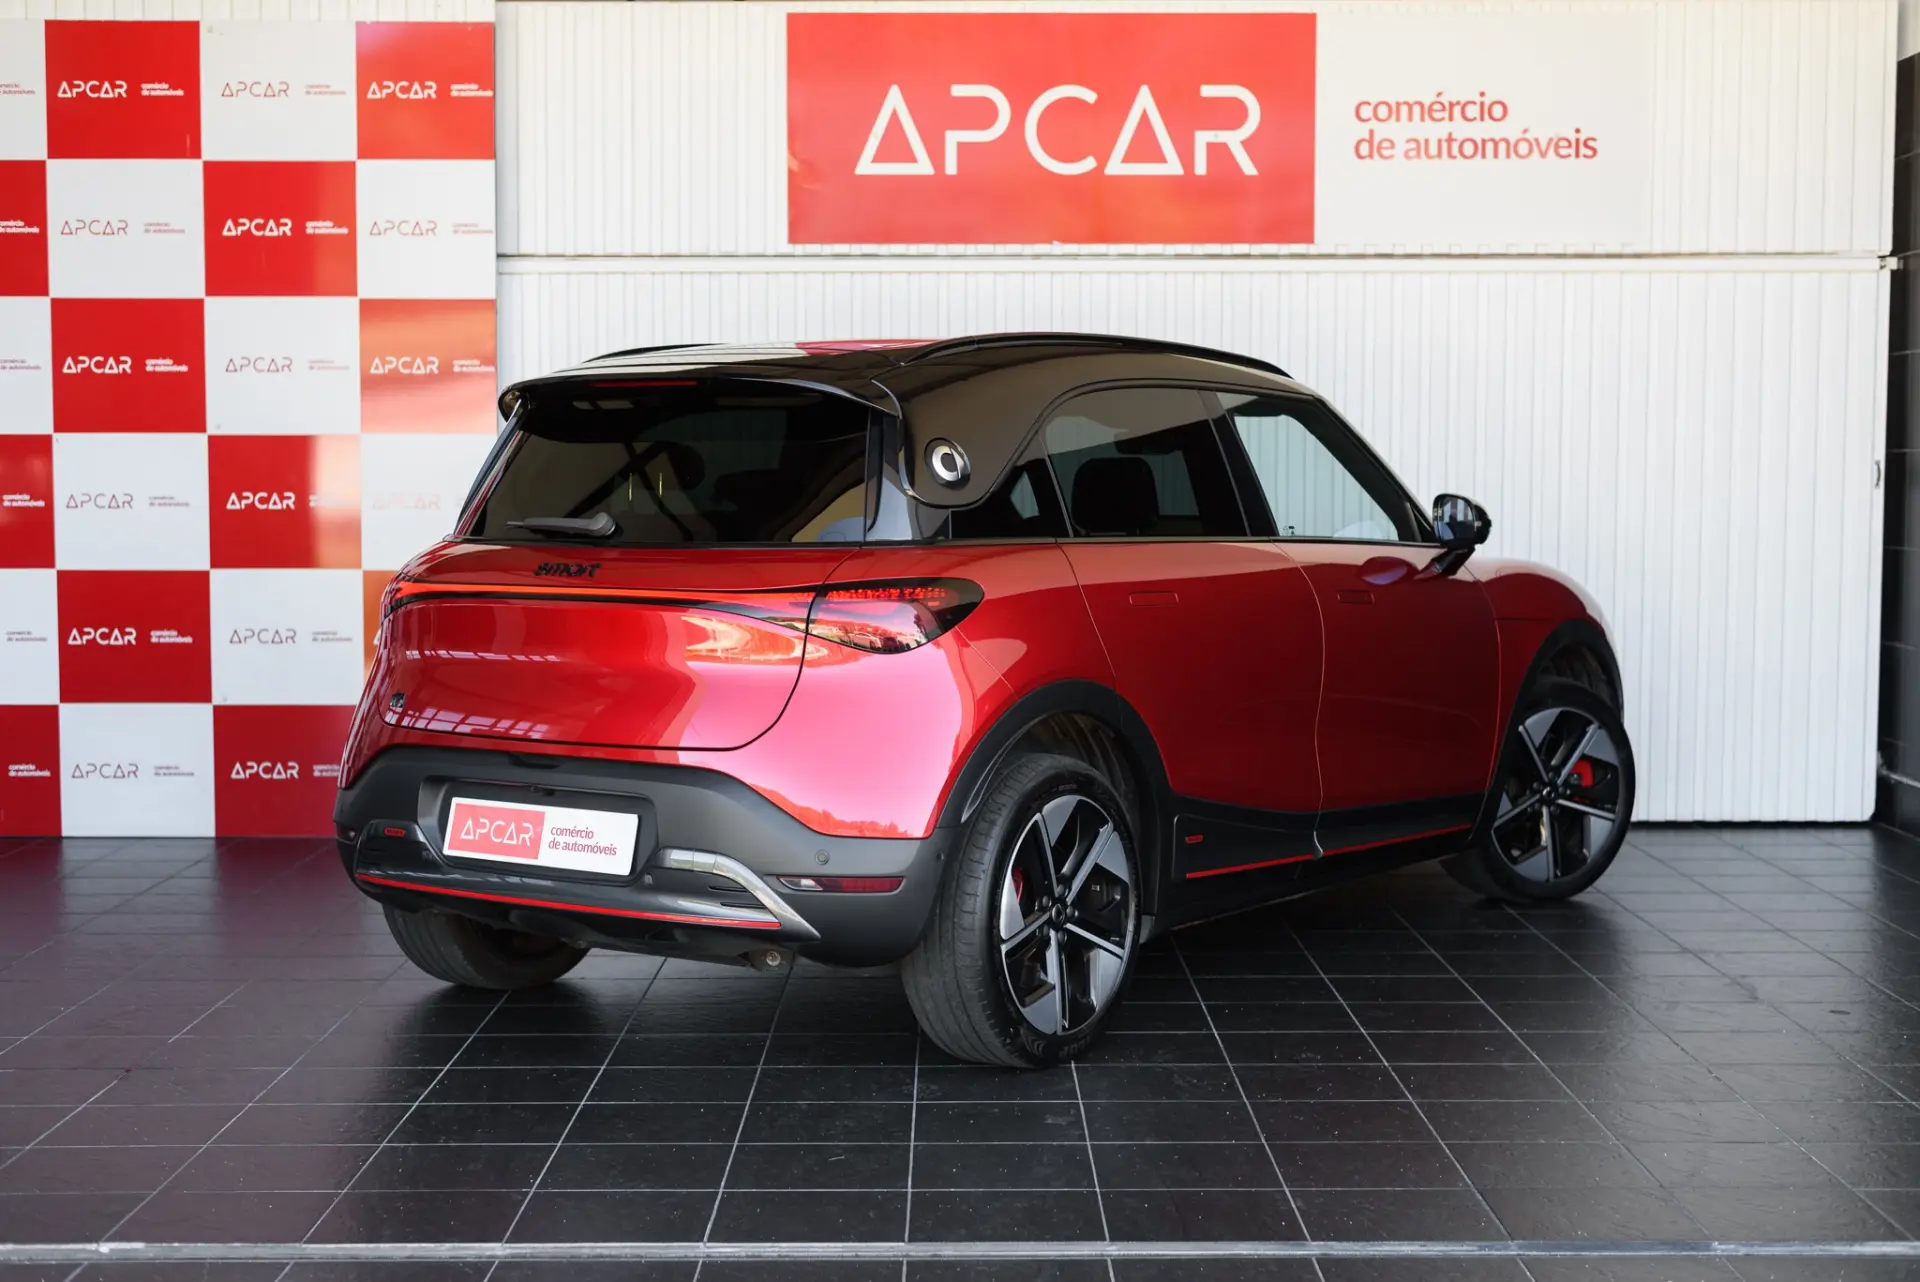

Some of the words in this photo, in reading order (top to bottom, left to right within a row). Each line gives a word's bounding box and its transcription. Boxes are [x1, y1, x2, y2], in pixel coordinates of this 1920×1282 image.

[58, 81, 127, 98] APCAR
[221, 81, 289, 97] APCAR
[367, 81, 437, 99] APCAR
[1355, 92, 1508, 122] comércio
[855, 84, 1261, 175] APCAR
[1354, 129, 1395, 160] de
[1403, 128, 1597, 160] automóveis
[61, 219, 128, 235] APCAR
[222, 218, 292, 236] APCAR
[369, 220, 437, 237] APCAR
[63, 356, 131, 374] APCAR
[226, 357, 292, 373] APCAR
[370, 356, 438, 374] APCAR
[66, 493, 133, 509] APCAR
[226, 492, 295, 509] APCAR
[68, 628, 136, 646] APCAR
[230, 629, 296, 645] APCAR
[72, 763, 138, 779] APCAR
[231, 762, 299, 779] APCAR
[460, 817, 533, 846] APCAR
[551, 825, 594, 839] comércio
[548, 837, 561, 850] de
[562, 840, 617, 856] automóveis
